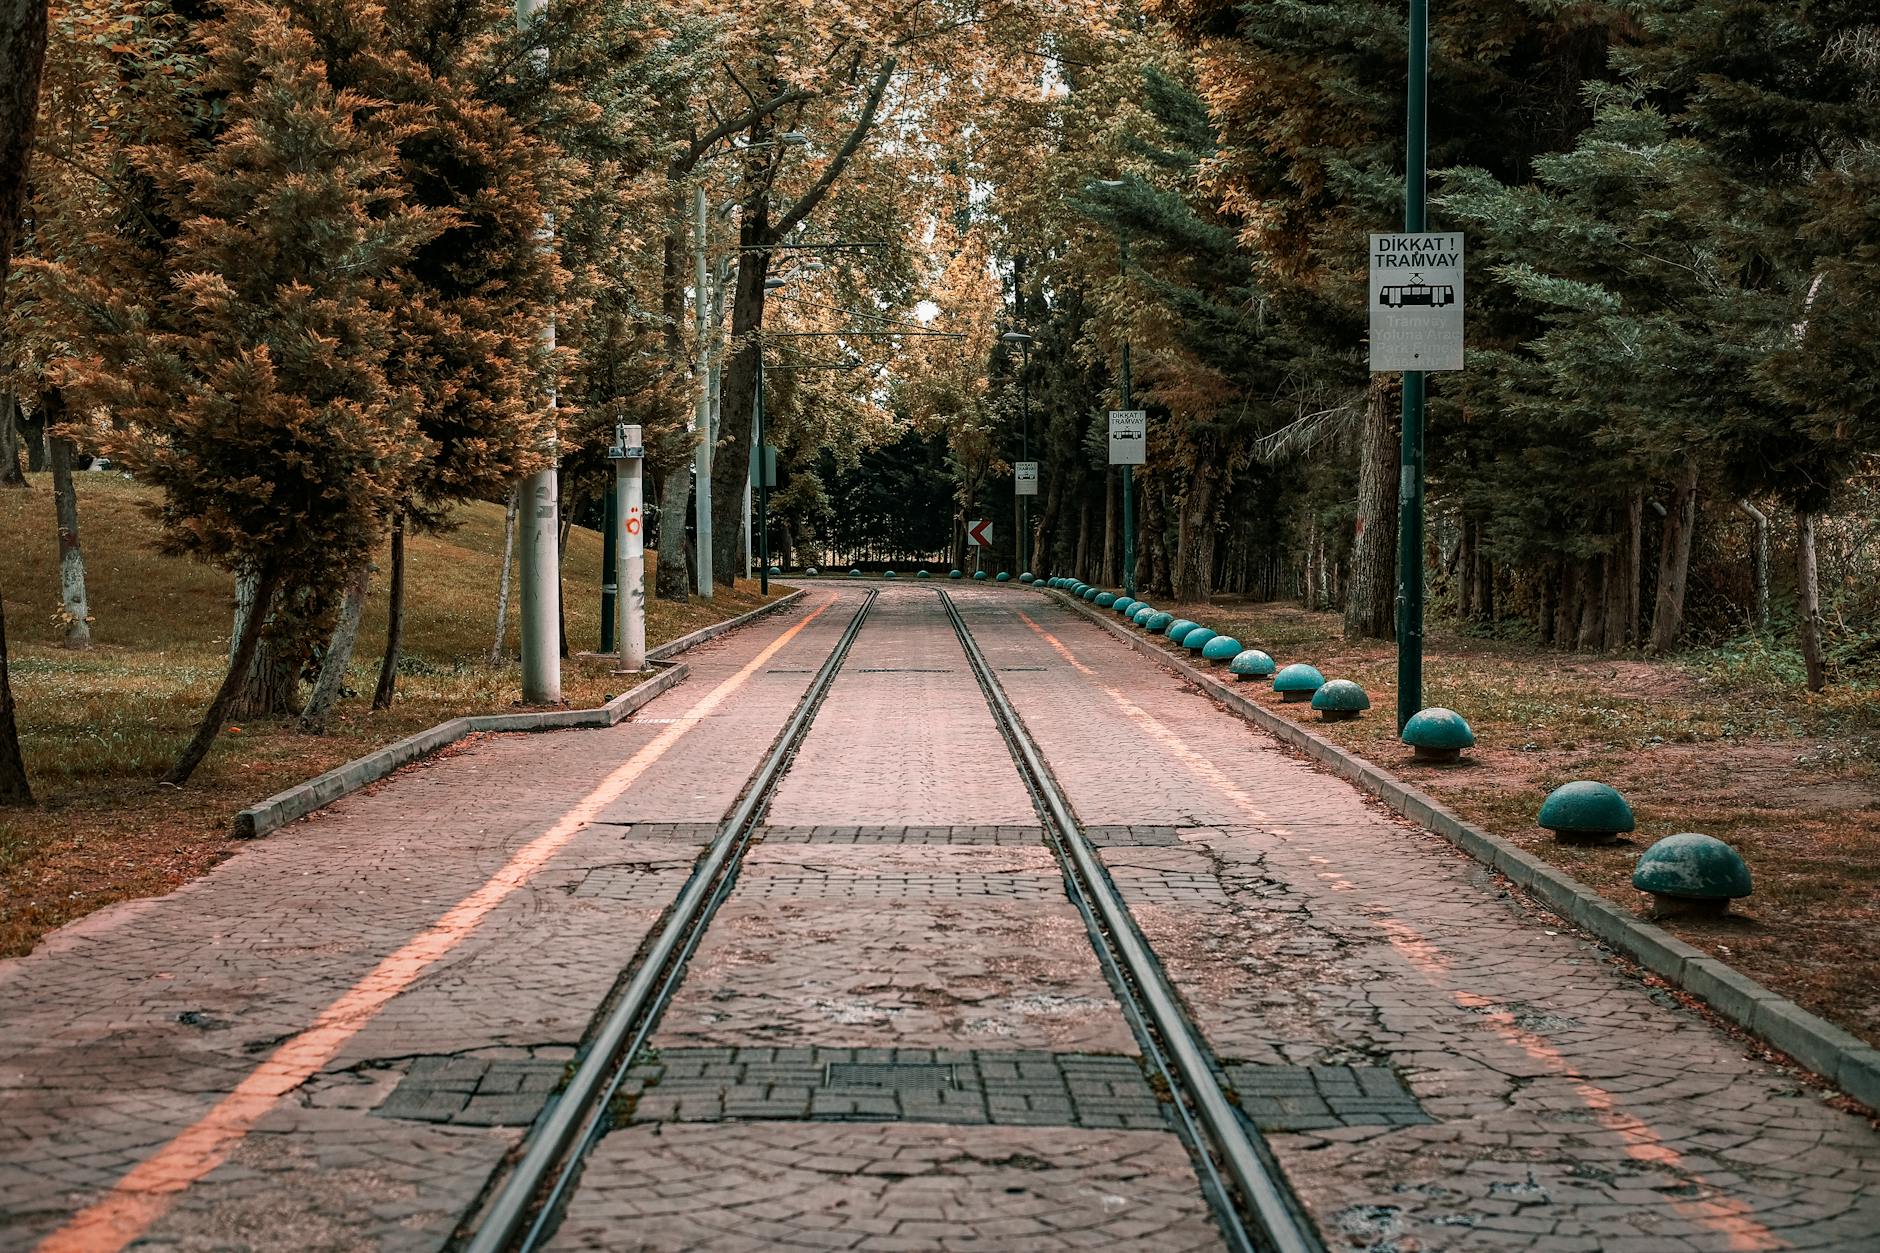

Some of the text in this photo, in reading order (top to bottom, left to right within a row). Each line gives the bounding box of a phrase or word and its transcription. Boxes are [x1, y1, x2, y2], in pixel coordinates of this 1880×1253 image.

[1379, 235, 1444, 251] DİKKAT
[1375, 254, 1459, 267] TRAMVAY
[1386, 314, 1447, 328] Tramvay
